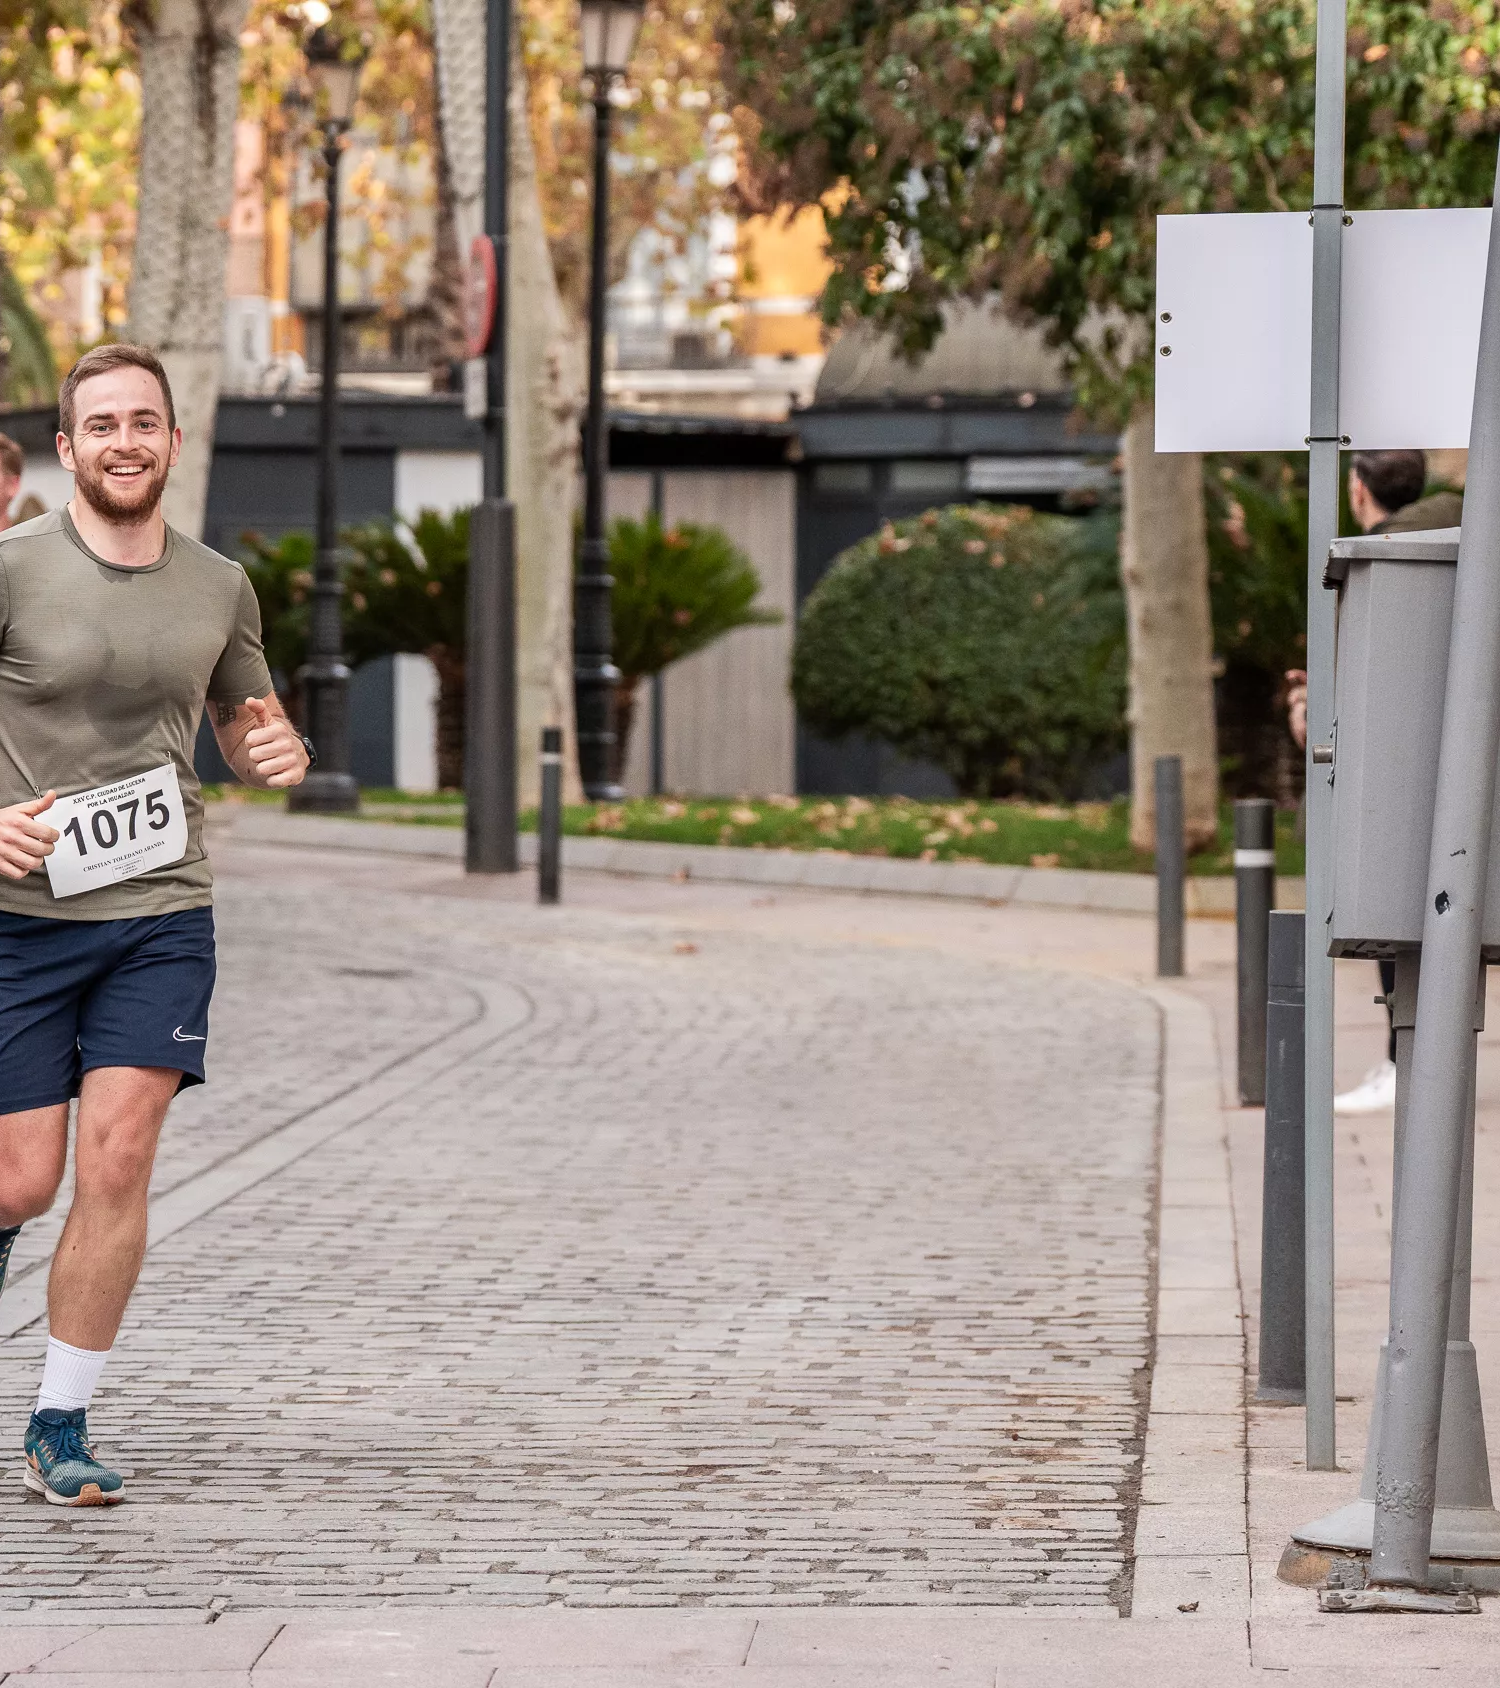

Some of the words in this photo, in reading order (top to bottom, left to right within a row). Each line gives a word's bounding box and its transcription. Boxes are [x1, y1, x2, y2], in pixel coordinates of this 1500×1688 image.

[72, 795, 85, 804] XXV
[86, 793, 97, 801] C.P.
[97, 787, 118, 798] CIUDAD
[126, 777, 146, 788] LUCENA
[108, 789, 135, 802] IGUALDAD
[63, 789, 170, 857] 1075
[82, 859, 112, 872] CRISTIAN
[112, 848, 143, 864] TOLEDANO
[143, 840, 165, 853] ARANDA
